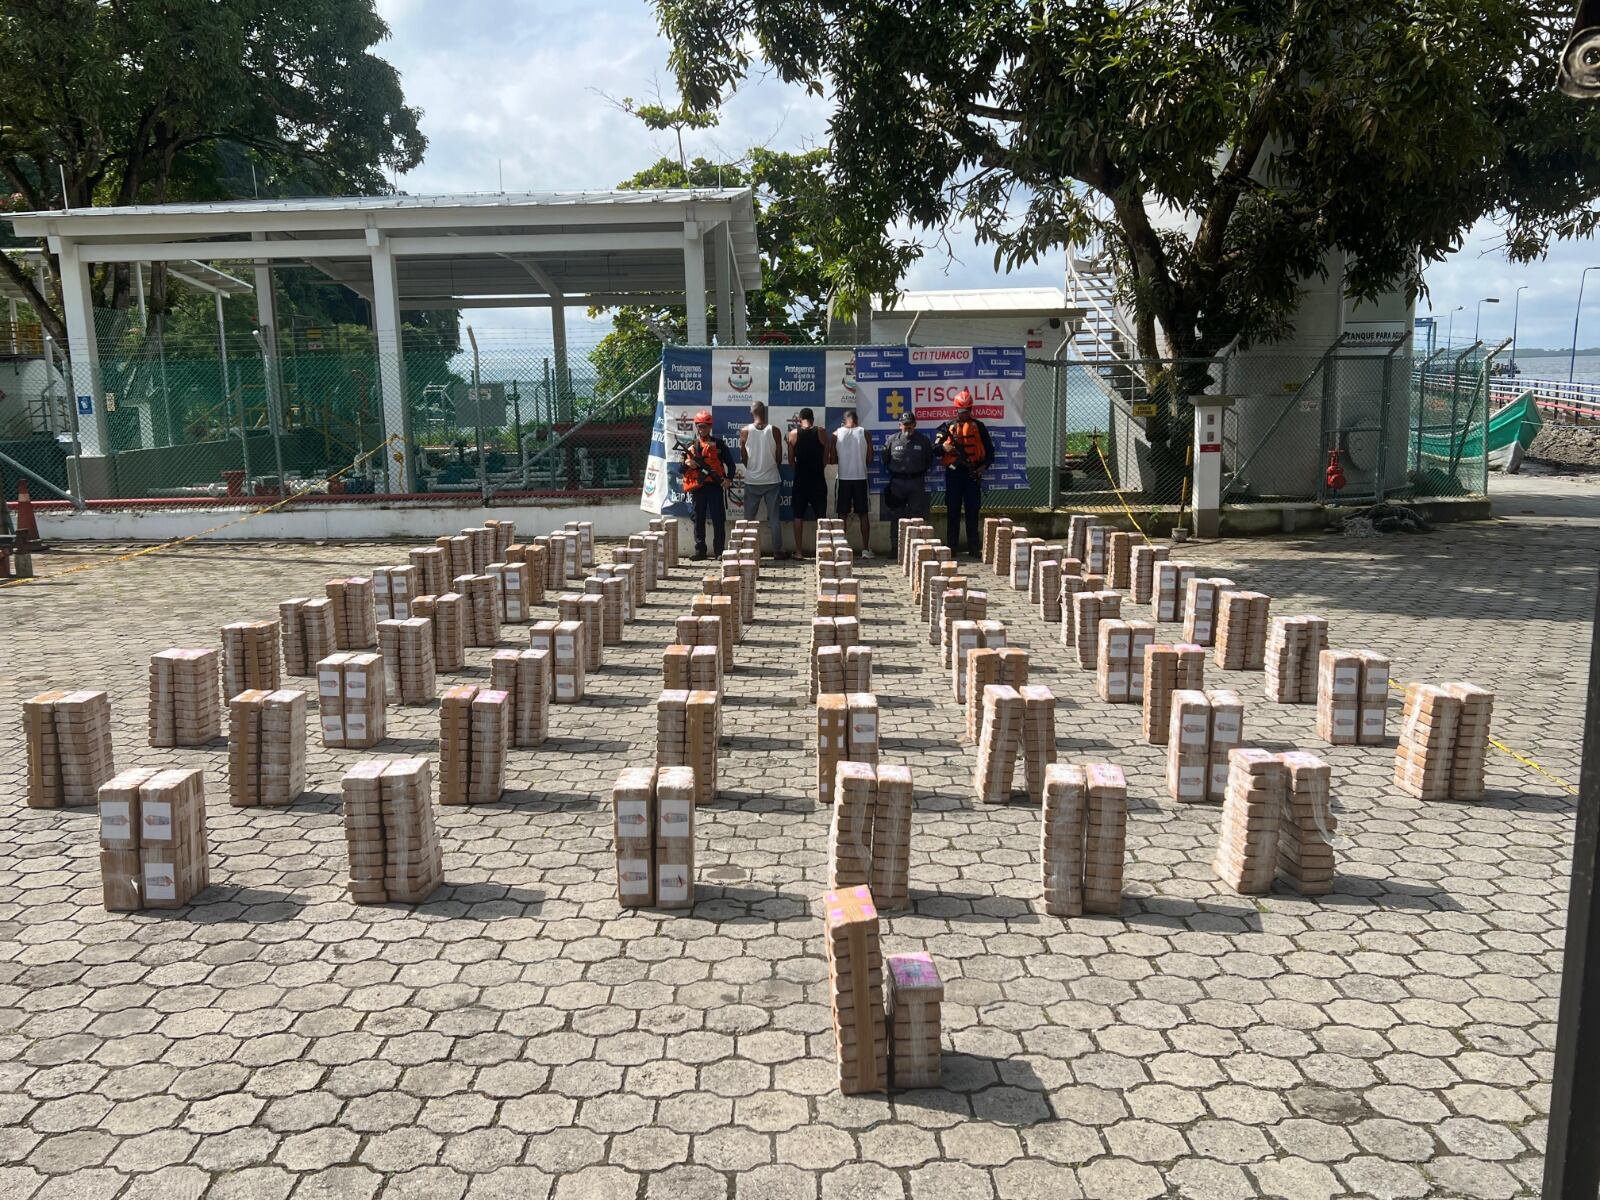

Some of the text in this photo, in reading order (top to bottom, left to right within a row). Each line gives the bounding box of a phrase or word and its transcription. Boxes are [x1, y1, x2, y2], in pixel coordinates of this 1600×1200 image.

[1346, 332, 1375, 340] TANQUE
[912, 351, 927, 361] CTI
[929, 350, 970, 361] TUMACO
[672, 364, 702, 374] Protegemos
[785, 365, 815, 374] Protegemos
[667, 377, 702, 391] bandera
[779, 378, 815, 392] bandera
[916, 410, 951, 418] GENERAL
